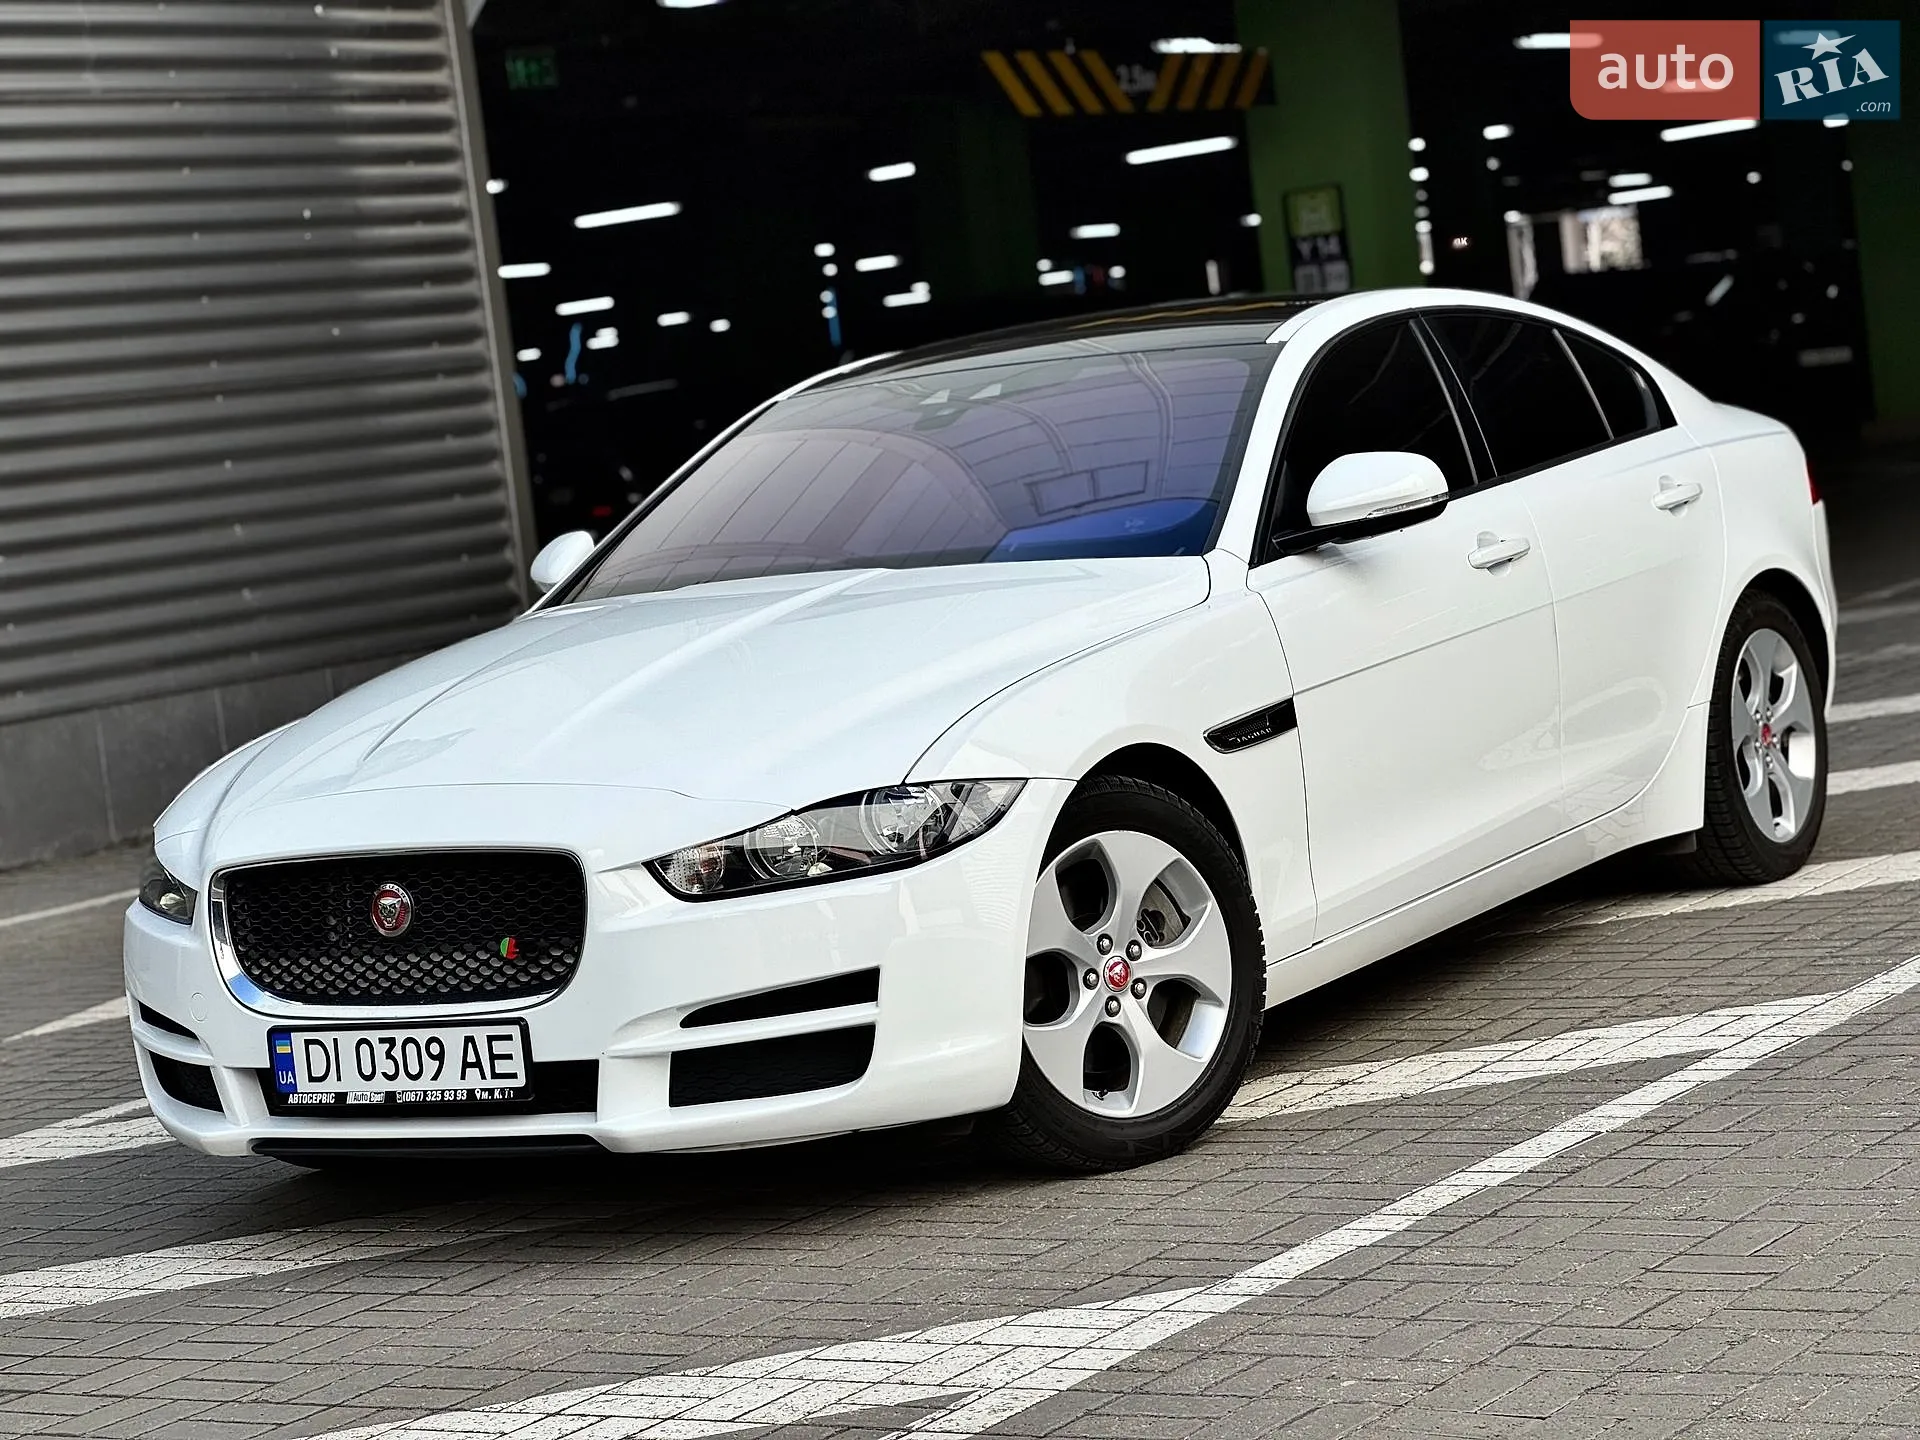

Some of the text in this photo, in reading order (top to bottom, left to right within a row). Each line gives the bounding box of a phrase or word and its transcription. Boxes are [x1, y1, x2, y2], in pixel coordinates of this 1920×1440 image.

[1236, 728, 1272, 742] JAGUAR
[304, 1034, 519, 1083] DI 0309 AE
[279, 1071, 295, 1084] UA
[426, 1091, 442, 1101] 325
[444, 1090, 455, 1101] 93
[456, 1090, 467, 1100] 93
